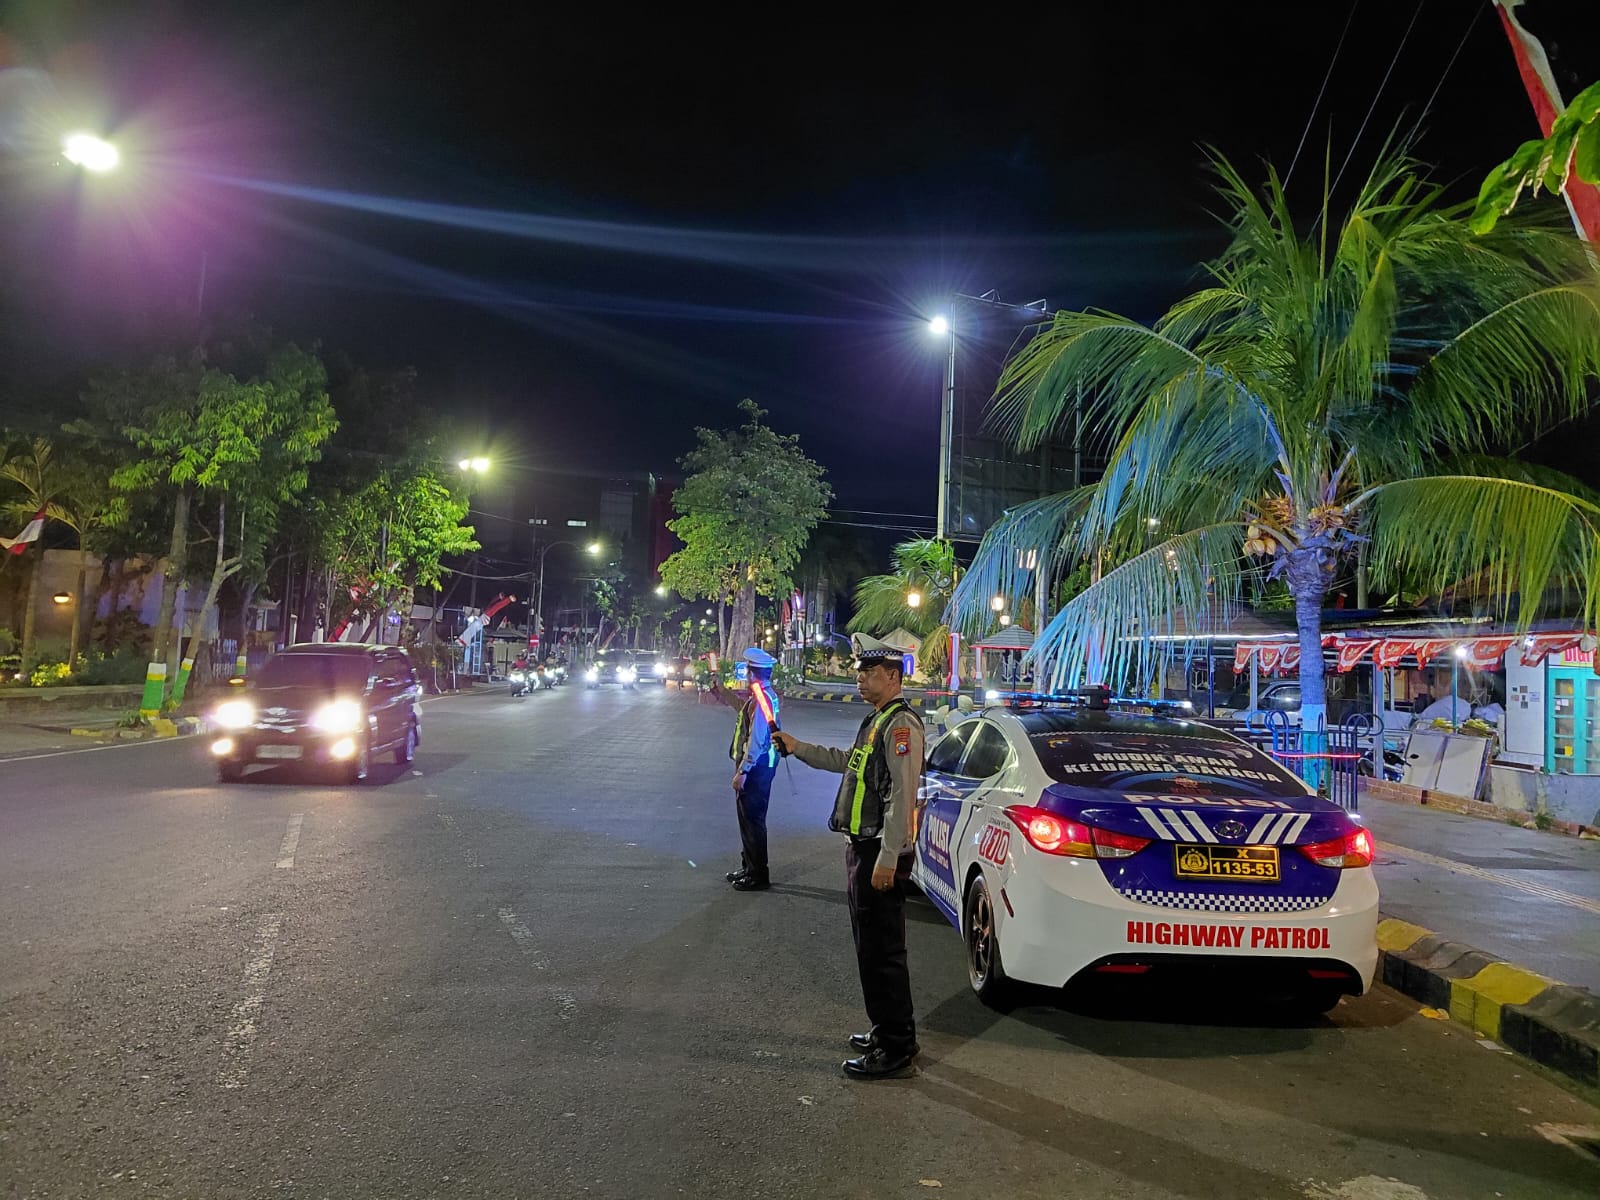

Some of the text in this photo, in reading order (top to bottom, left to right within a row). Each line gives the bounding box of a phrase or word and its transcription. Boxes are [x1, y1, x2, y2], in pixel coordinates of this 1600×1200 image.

[1094, 752, 1237, 768] MUDIK AMAN
[1063, 763, 1281, 782] KELUARGA BAHAGIA
[1122, 794, 1293, 809] POLISI
[928, 814, 950, 854] POLISI
[978, 824, 1010, 865] 110
[1236, 848, 1249, 859] X
[1212, 861, 1275, 876] 1135-53
[1126, 921, 1331, 949] HIGHWAY PATROL
